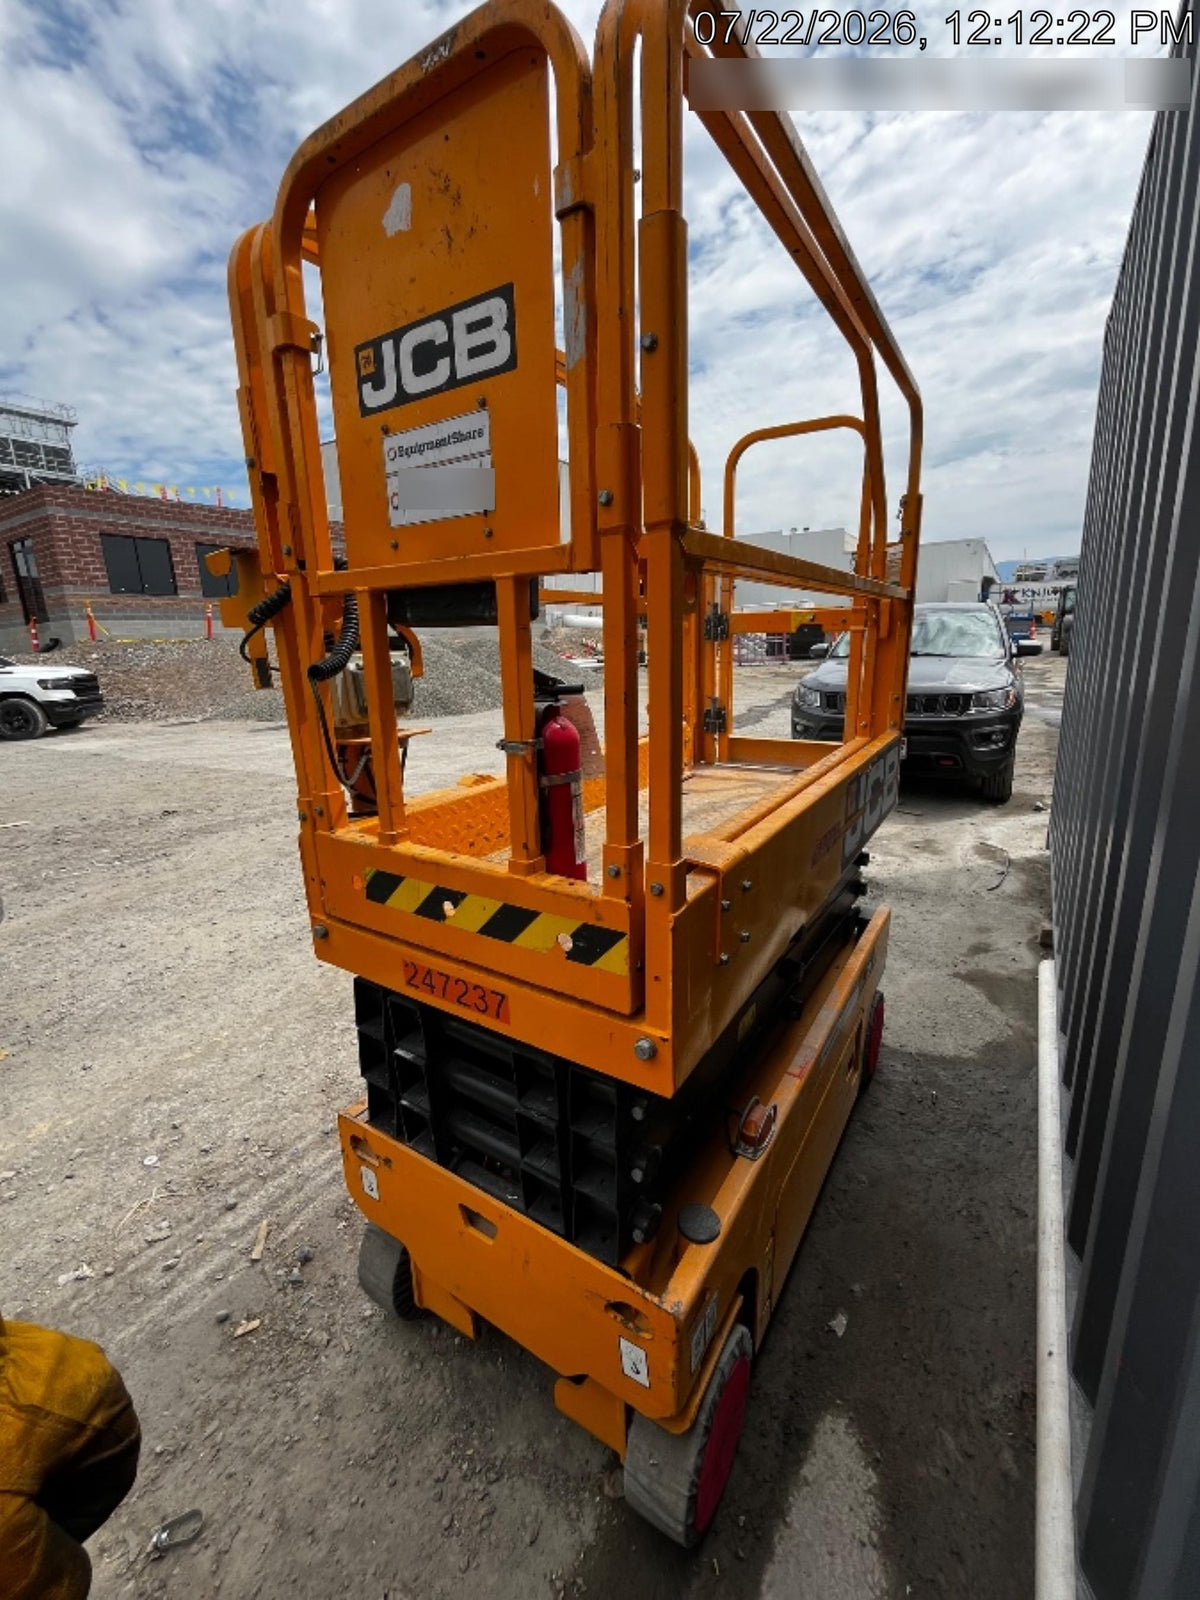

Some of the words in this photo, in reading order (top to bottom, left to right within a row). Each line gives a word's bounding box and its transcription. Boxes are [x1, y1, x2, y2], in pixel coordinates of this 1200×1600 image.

[362, 297, 511, 408] JCB
[397, 428, 485, 458] EquipmentShare
[404, 961, 506, 1019] 247237
